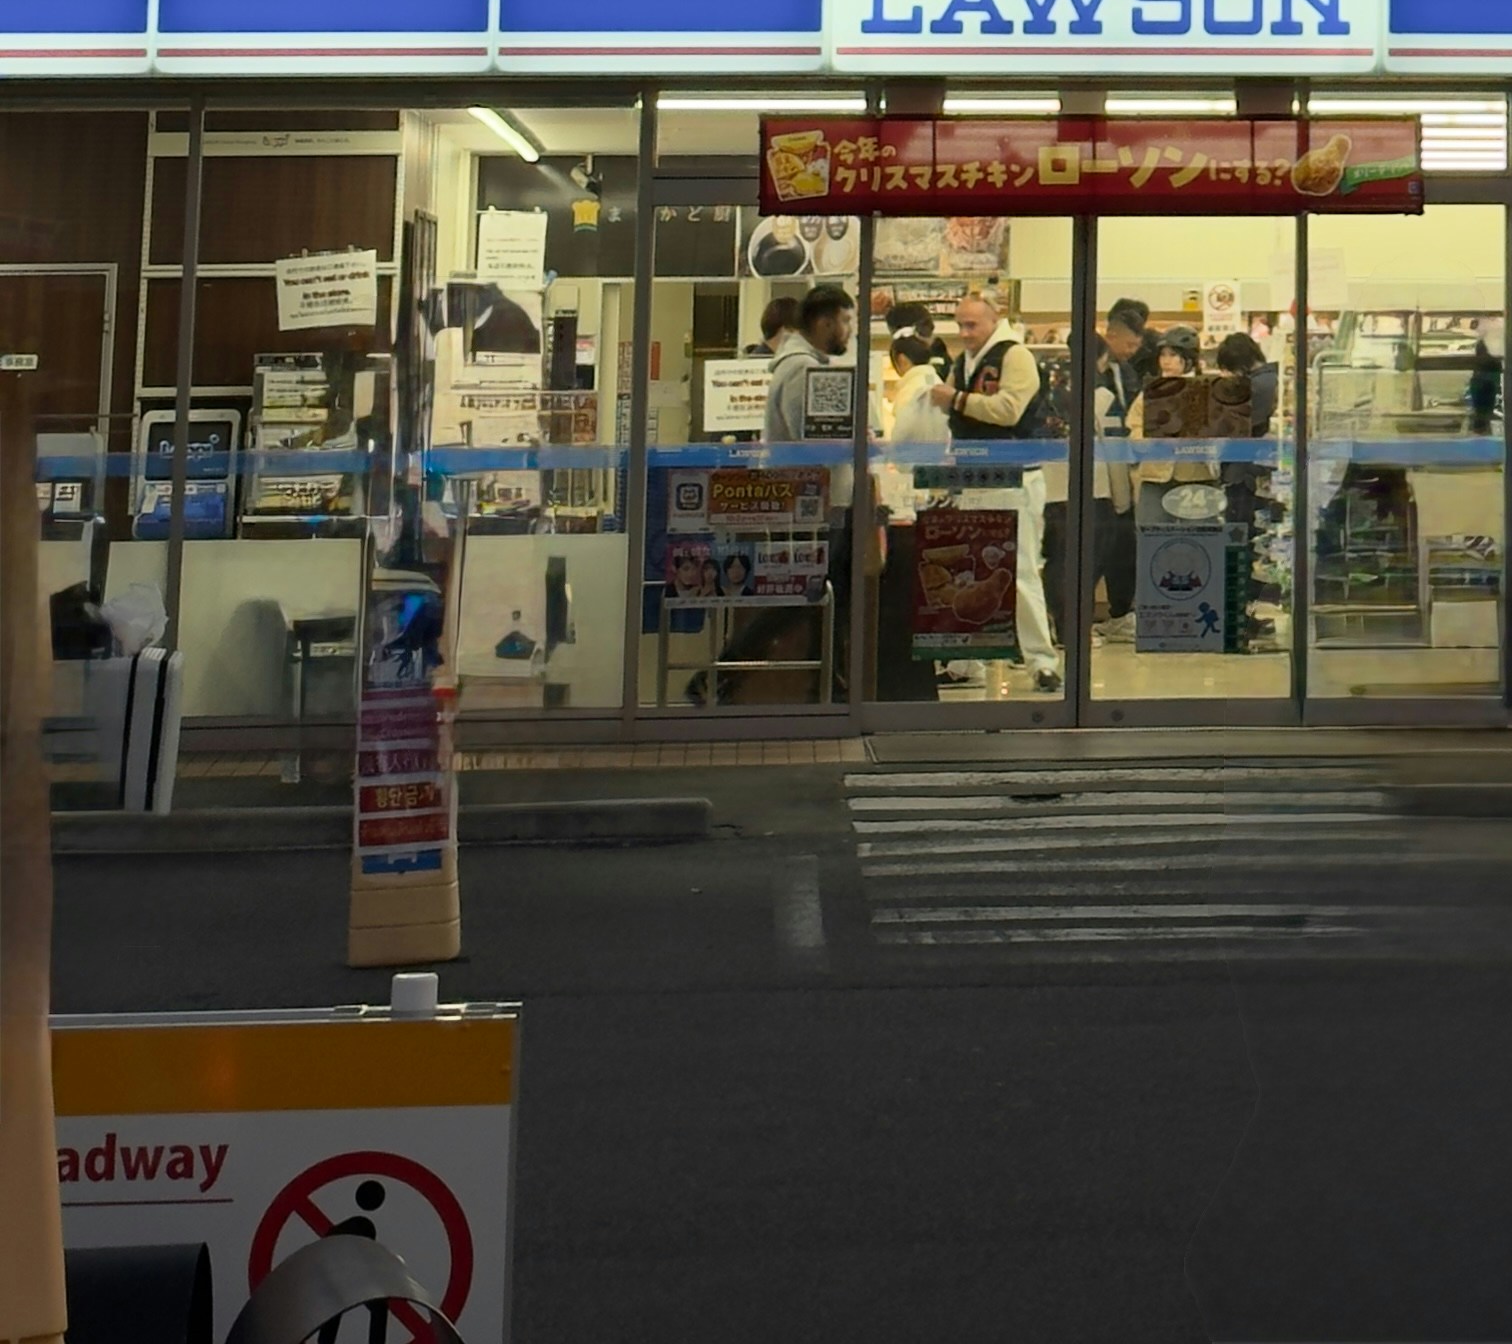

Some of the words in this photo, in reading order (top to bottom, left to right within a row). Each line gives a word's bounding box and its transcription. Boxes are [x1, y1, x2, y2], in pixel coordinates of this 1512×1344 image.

[833, 136, 897, 163] 今年の
[835, 161, 1034, 193] クリスマスチキン
[712, 483, 793, 499] Pontaパス
[1180, 488, 1207, 507] 24
[57, 1132, 230, 1193] adway
